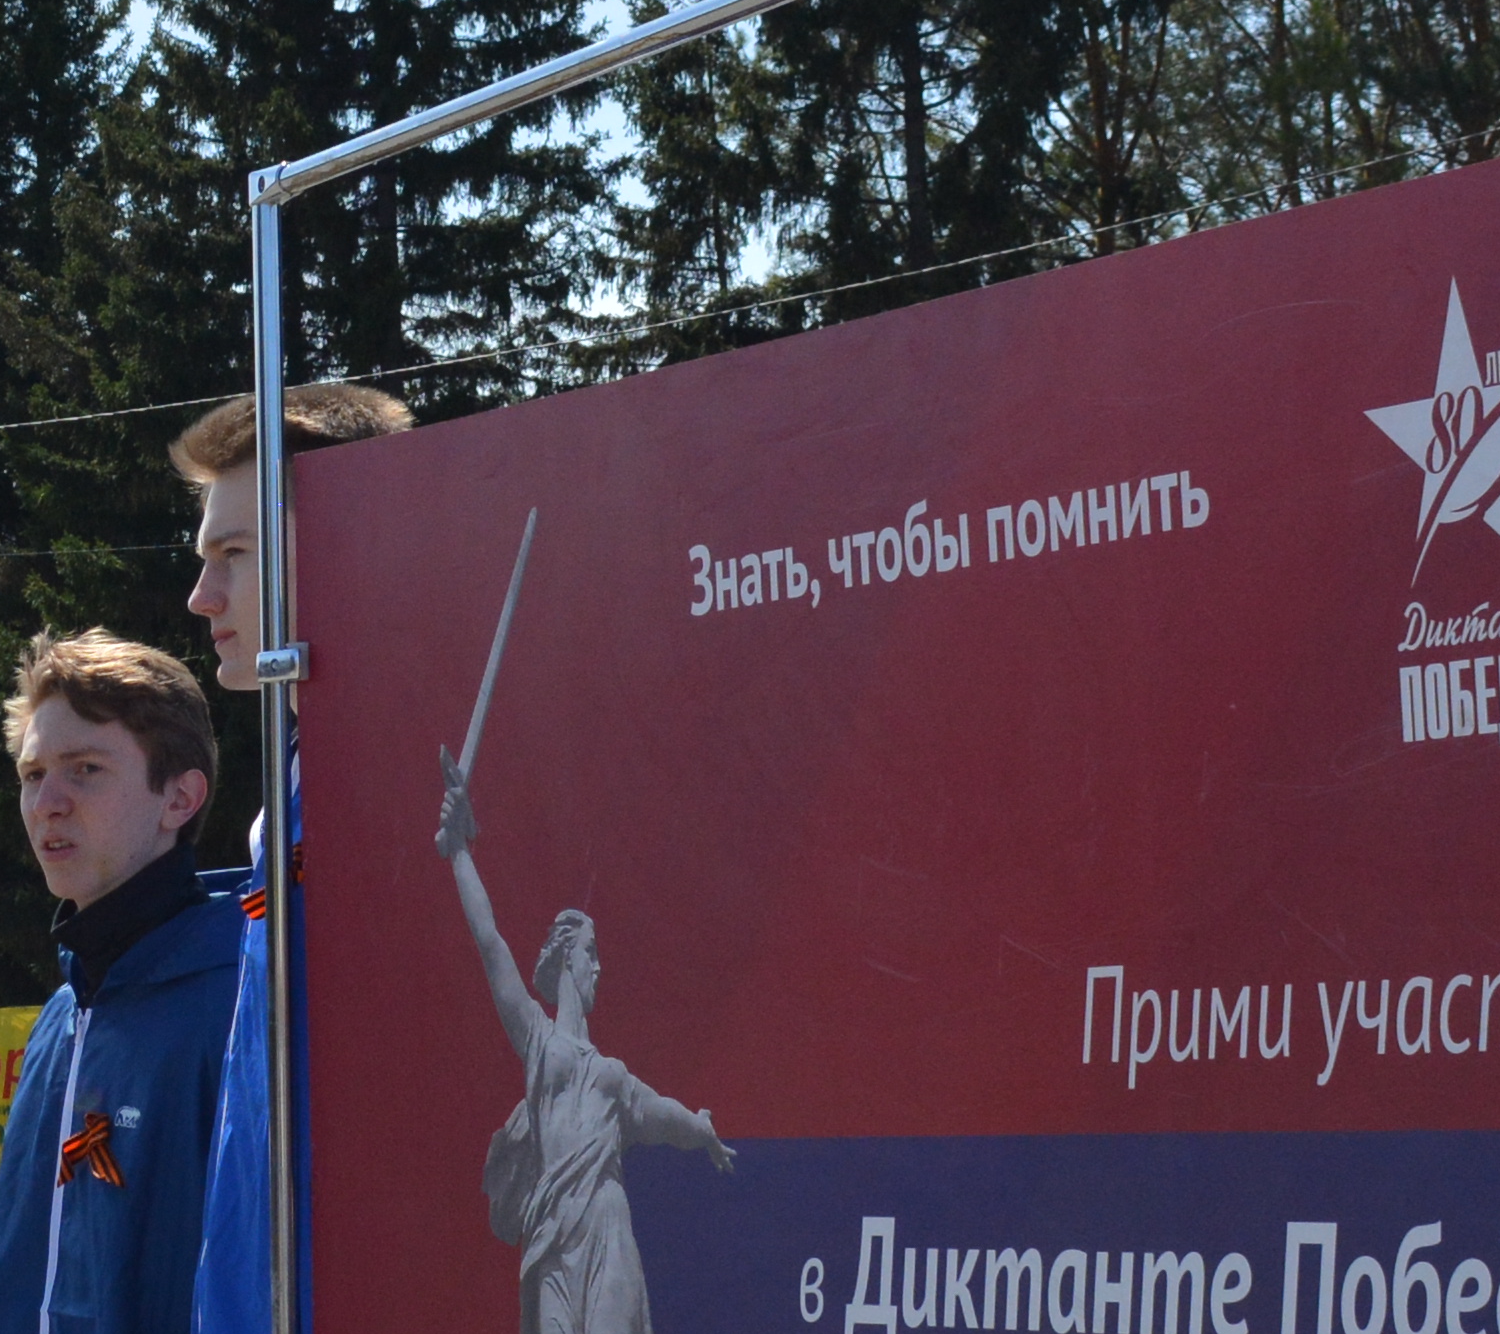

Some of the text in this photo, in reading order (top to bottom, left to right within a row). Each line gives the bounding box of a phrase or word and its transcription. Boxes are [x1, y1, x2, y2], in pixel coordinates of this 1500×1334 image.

[688, 470, 1210, 616] Знать, чтобы помнить
[1081, 962, 1292, 1091] Прими
[799, 1257, 824, 1324] в
